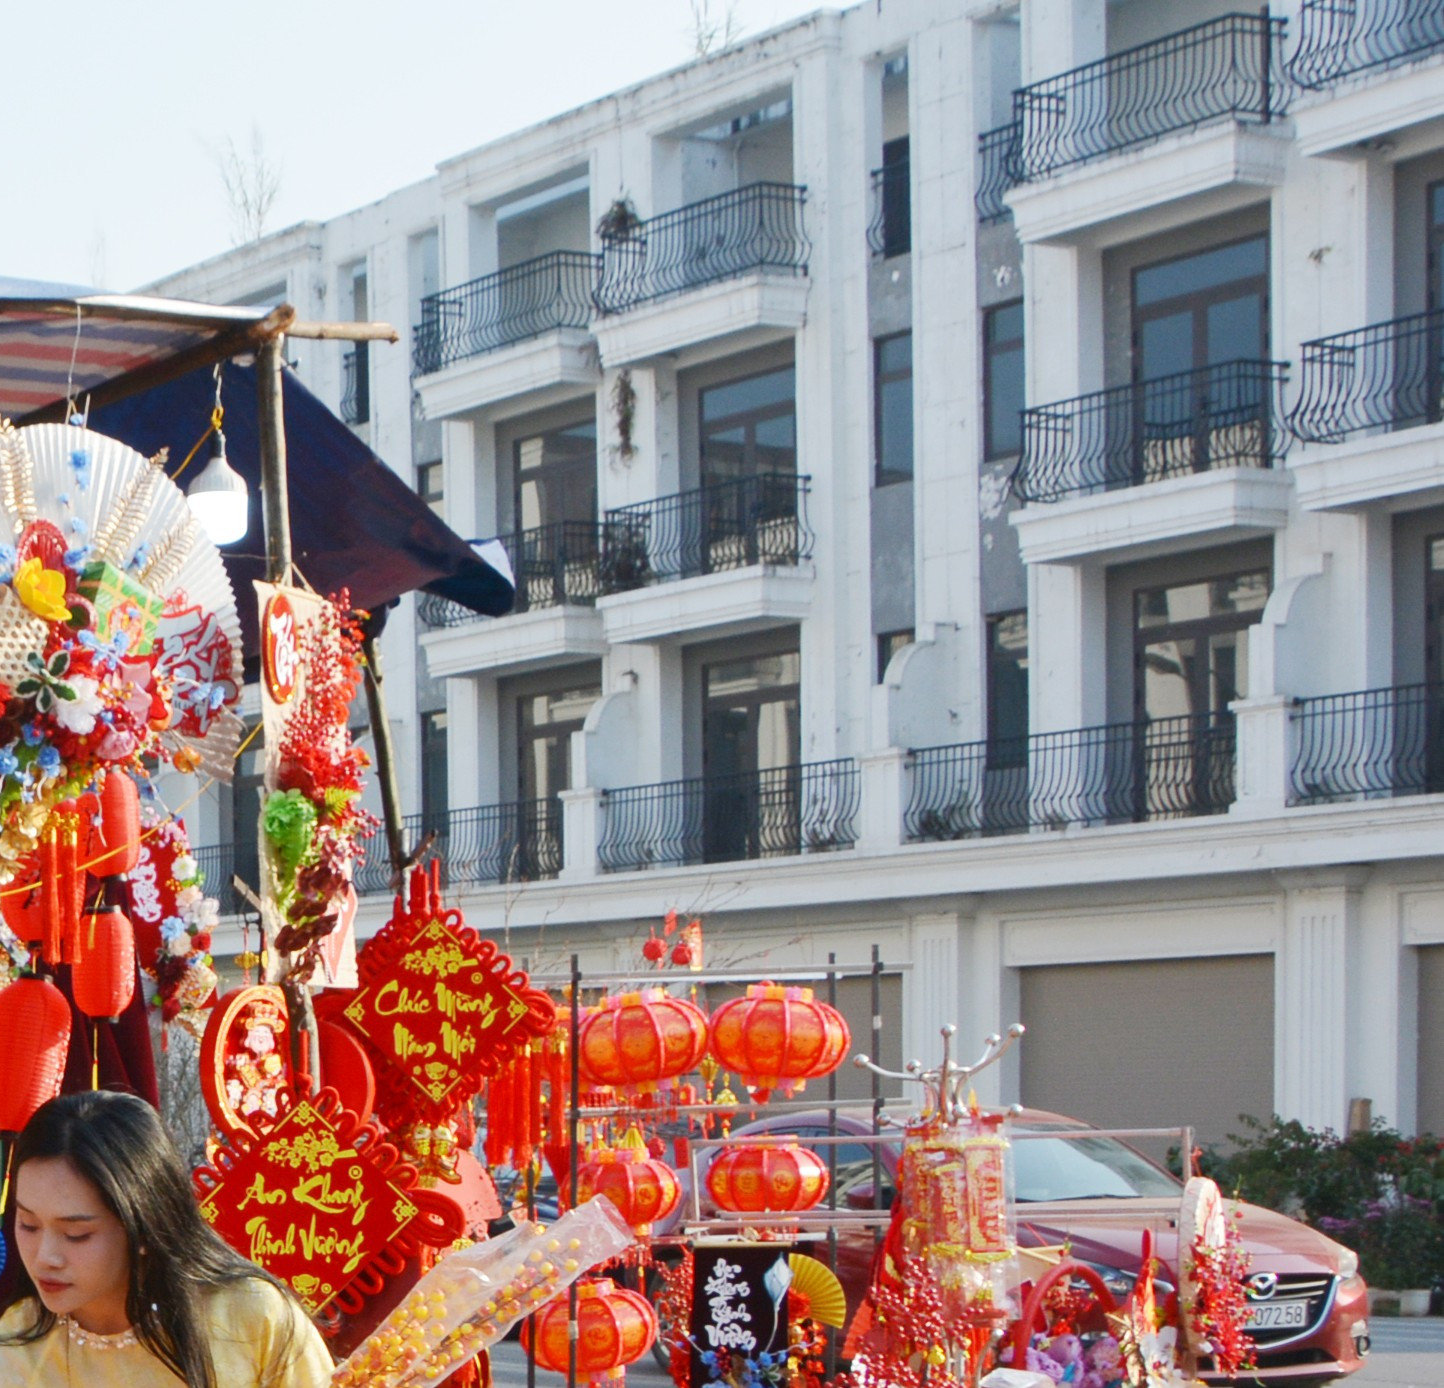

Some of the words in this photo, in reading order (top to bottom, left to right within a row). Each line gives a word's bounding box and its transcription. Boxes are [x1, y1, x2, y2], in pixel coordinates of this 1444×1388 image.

[374, 979, 433, 1016] Chúc
[433, 981, 504, 1030] Mừng
[236, 1171, 287, 1211] An
[292, 1171, 374, 1226] Khang
[298, 1213, 371, 1274] Vượng
